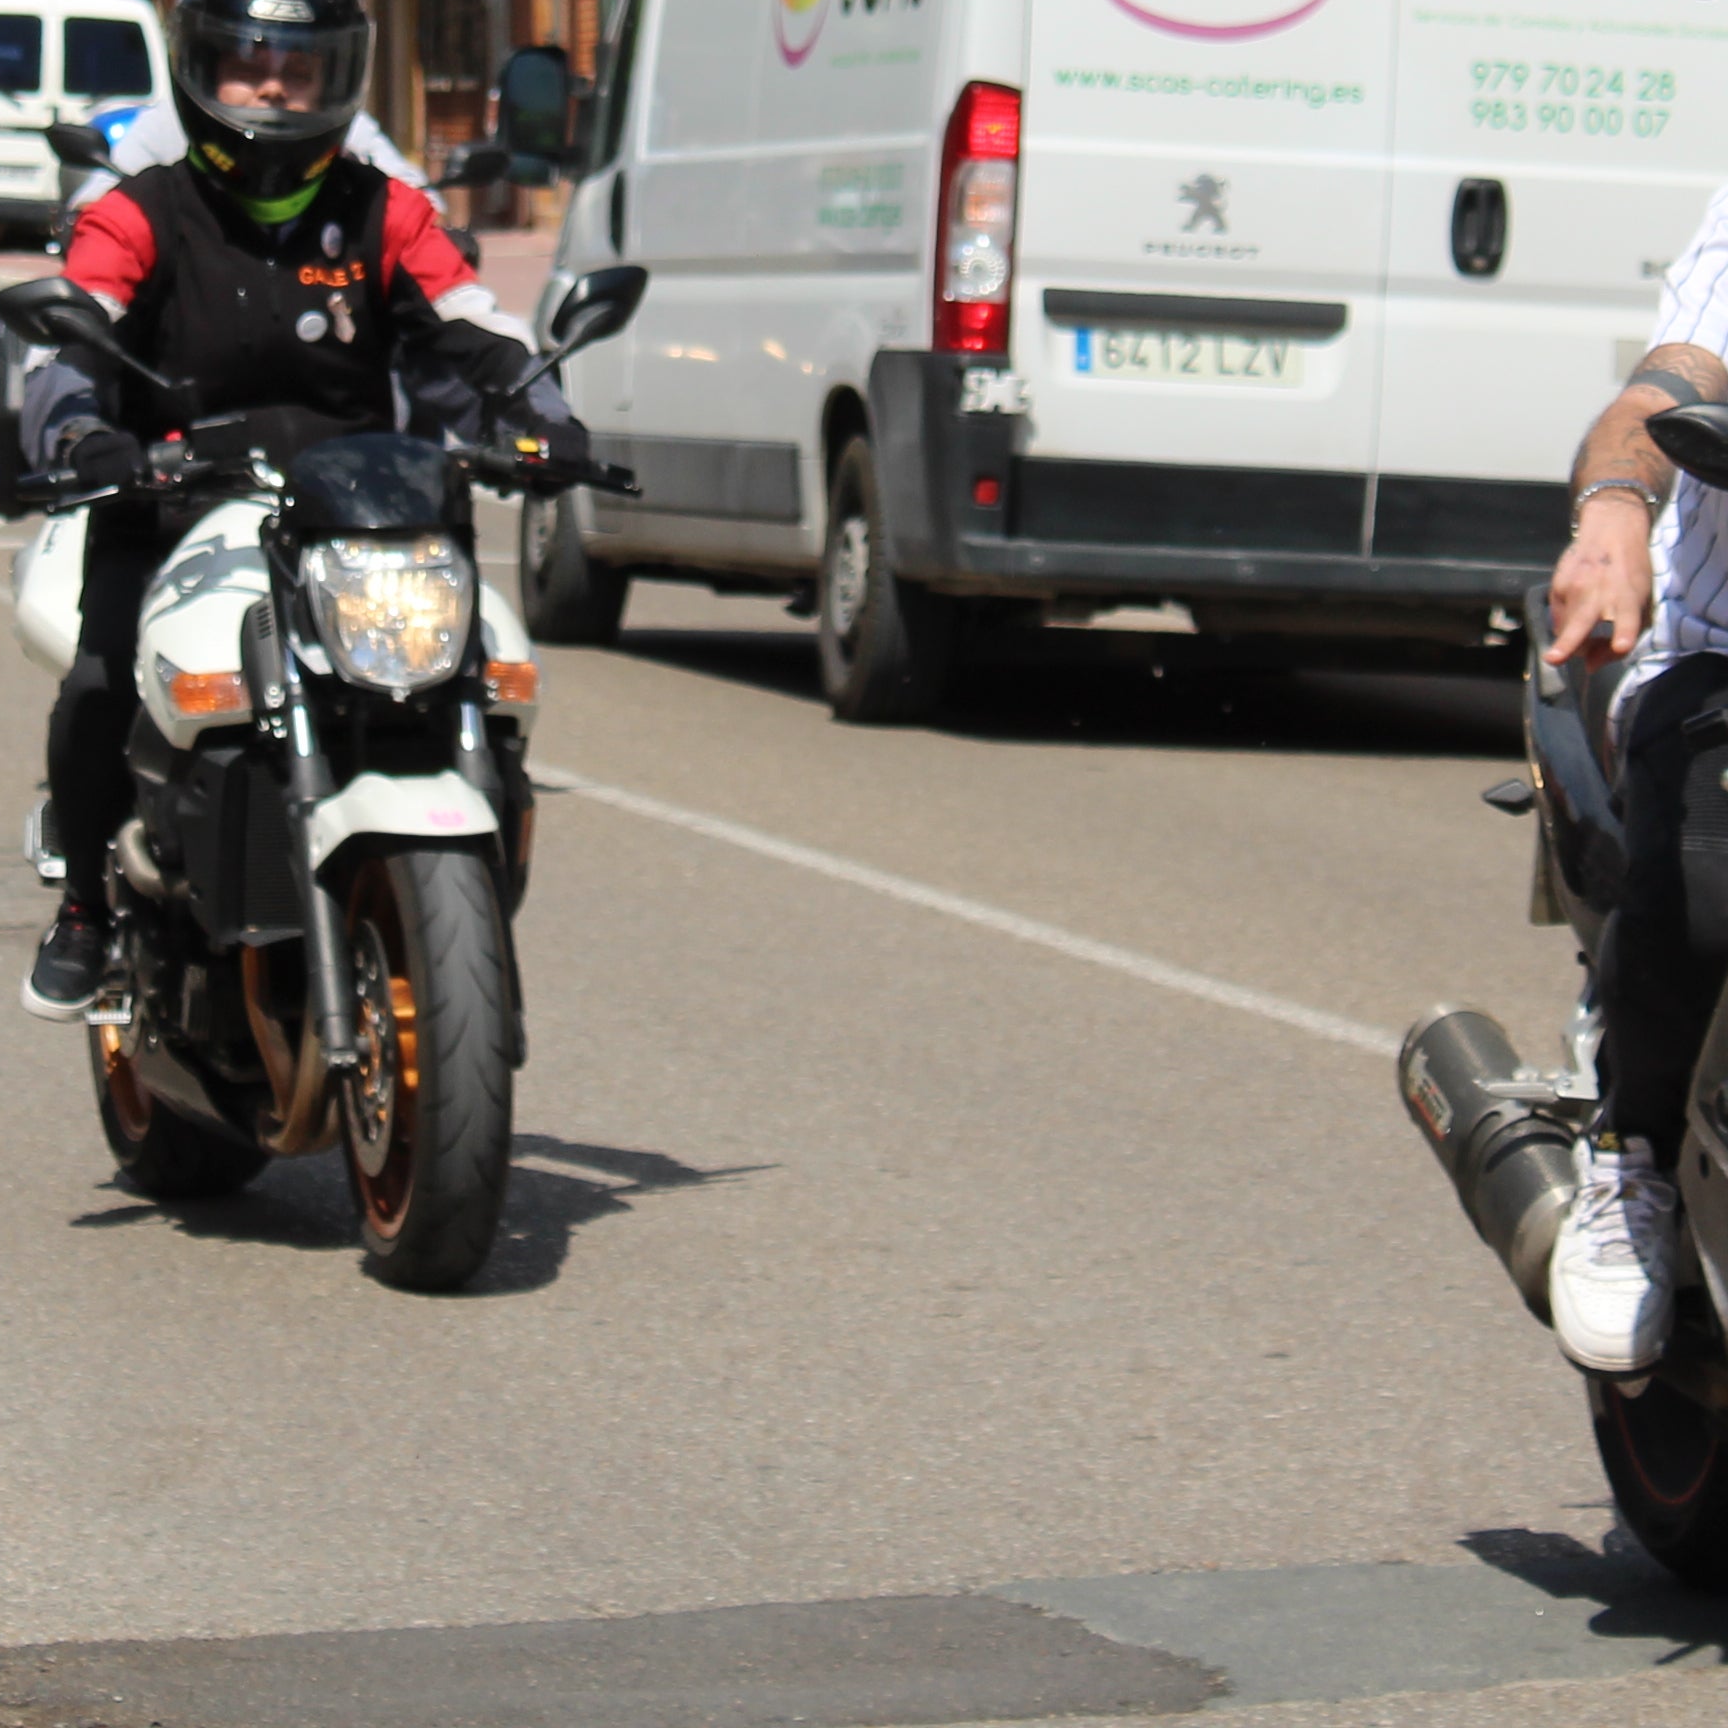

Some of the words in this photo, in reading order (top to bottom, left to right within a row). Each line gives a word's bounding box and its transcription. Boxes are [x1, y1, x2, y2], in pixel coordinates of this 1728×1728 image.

[1055, 69, 1364, 109] www.scas-catering.es
[1470, 60, 1529, 92] 979
[1540, 63, 1579, 96] 70
[1584, 68, 1624, 99] 24
[1636, 70, 1676, 101] 28
[1470, 99, 1528, 132] 983
[1538, 103, 1574, 134] 90
[1583, 108, 1623, 136] 00
[1633, 110, 1671, 139] 07
[1103, 329, 1202, 374] 6412
[1216, 336, 1289, 378] LZV
